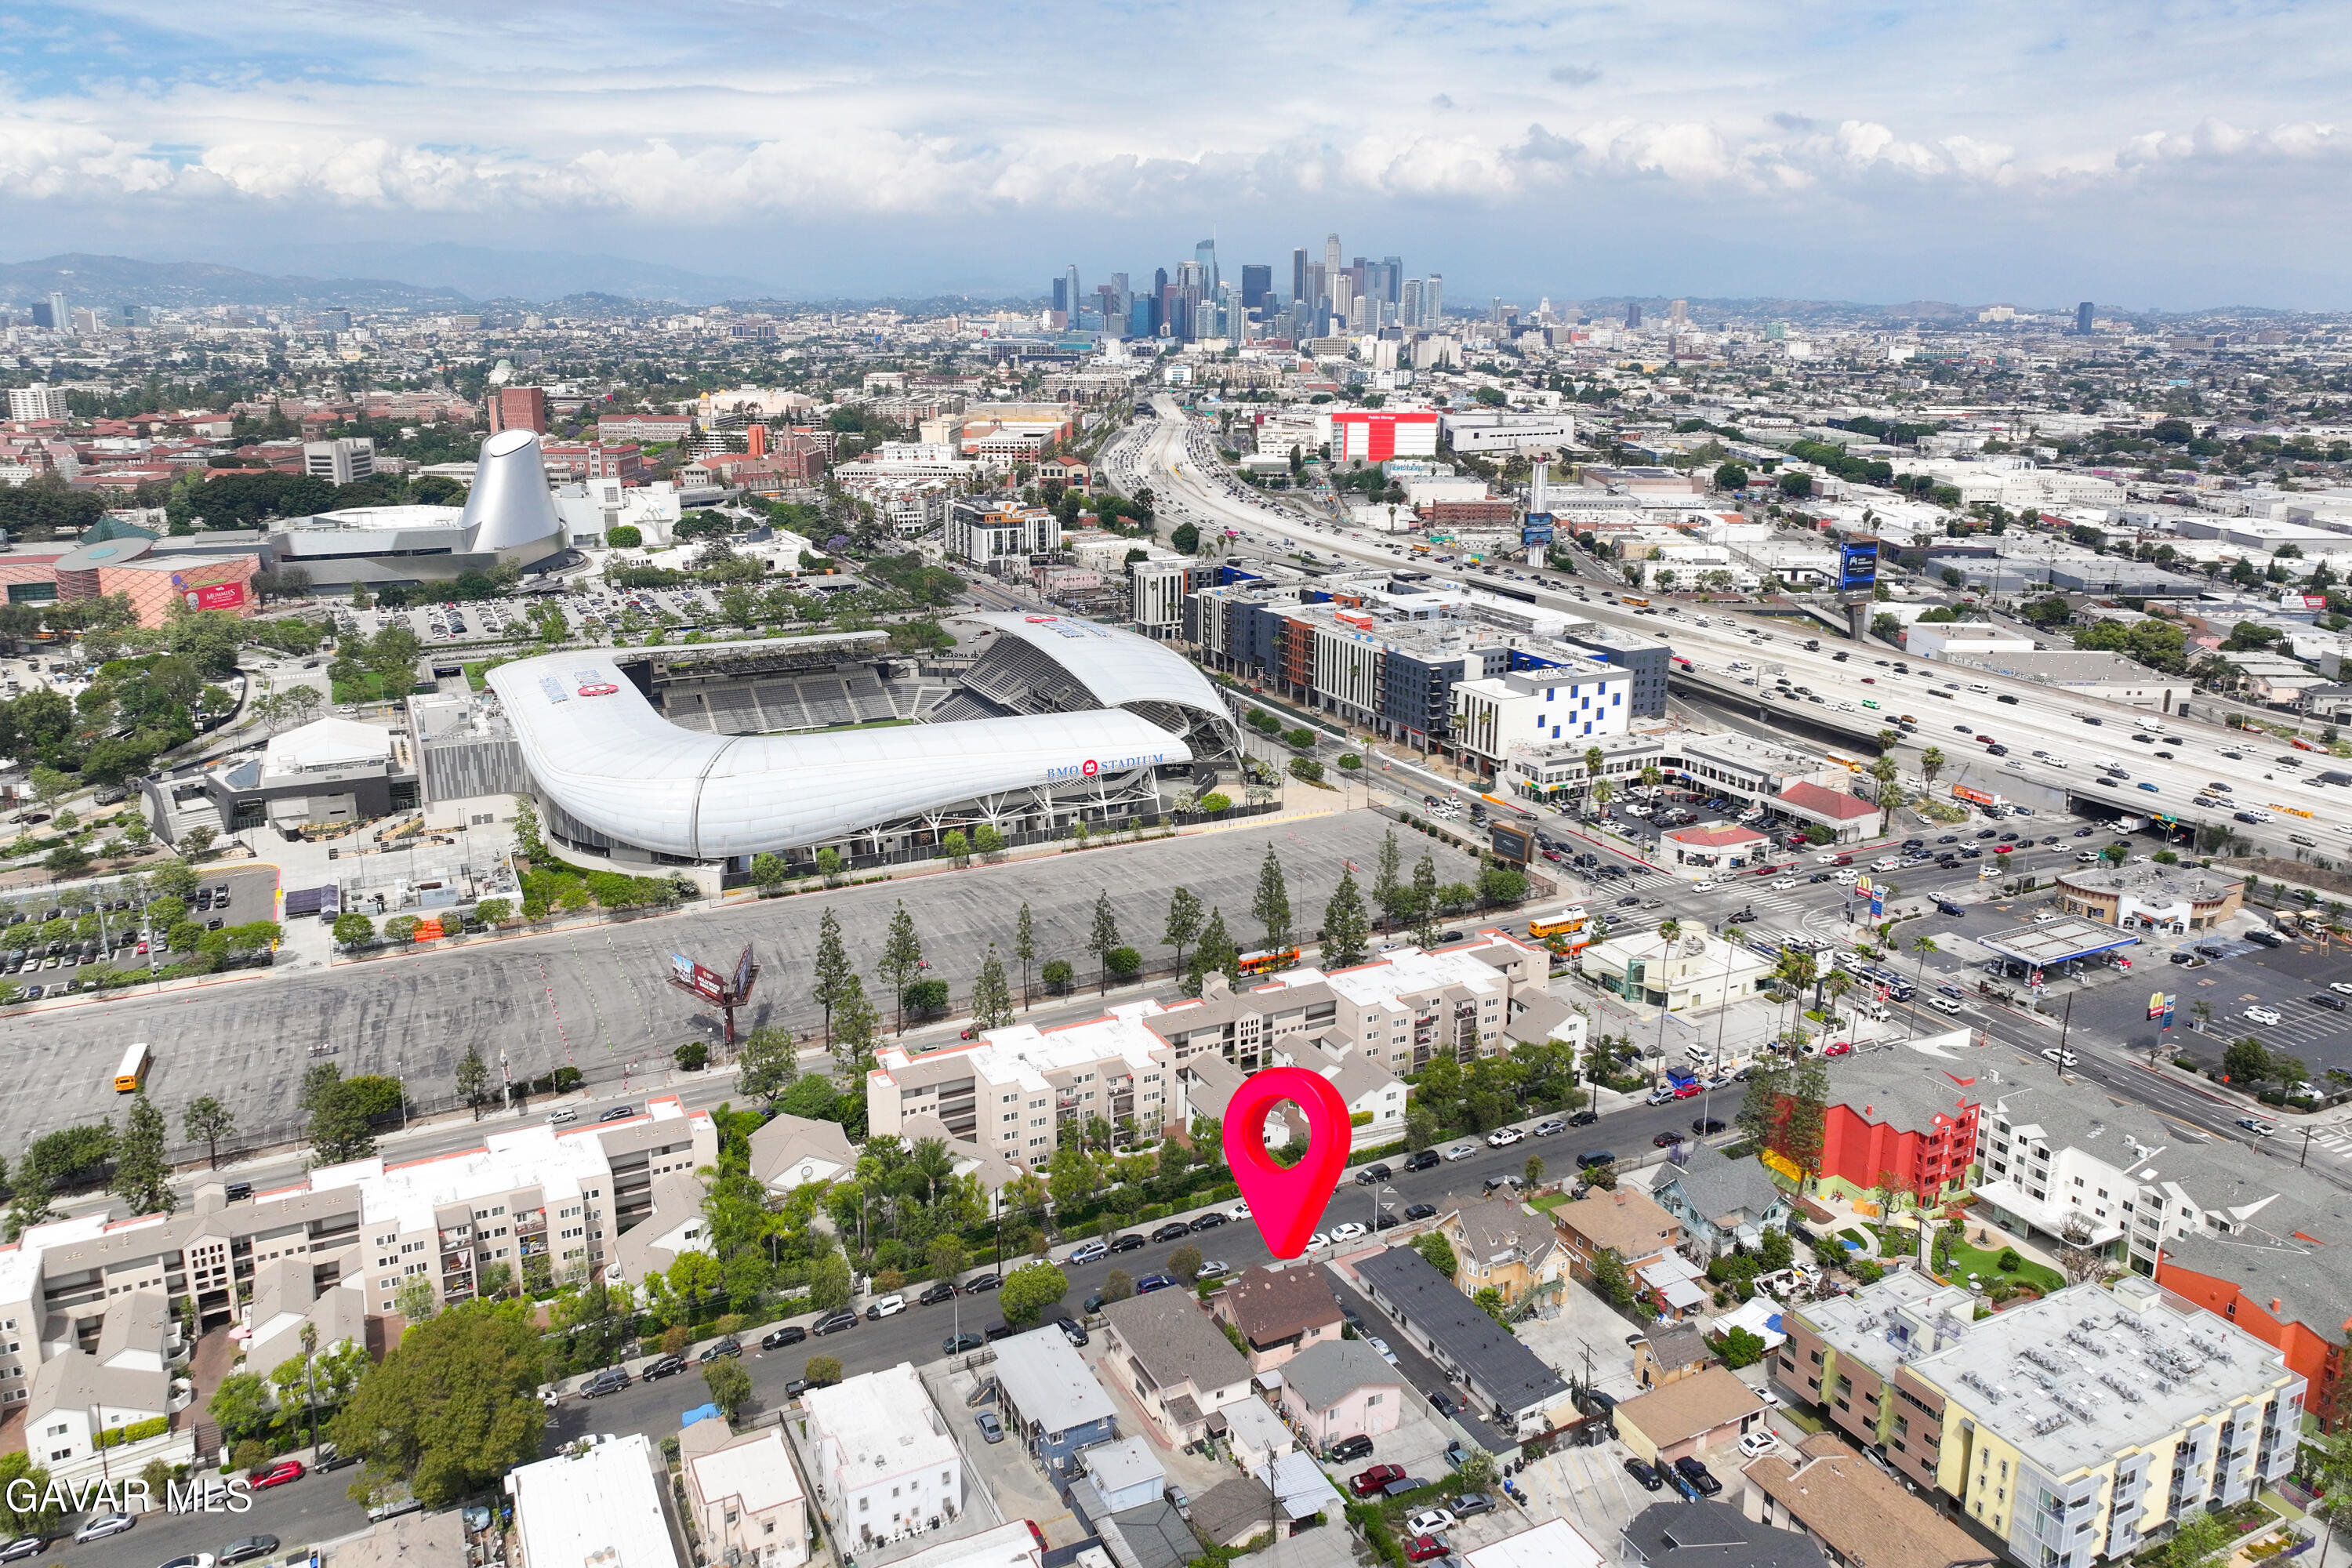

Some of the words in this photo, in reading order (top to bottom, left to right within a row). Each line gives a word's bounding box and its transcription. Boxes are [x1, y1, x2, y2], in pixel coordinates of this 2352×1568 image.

[206, 589, 235, 601] MUMMIES
[1047, 765, 1079, 778] BMO
[1101, 753, 1163, 771] STADIUM
[697, 975, 720, 991] HOLLYWOOD
[1889, 986, 1900, 997] LA
